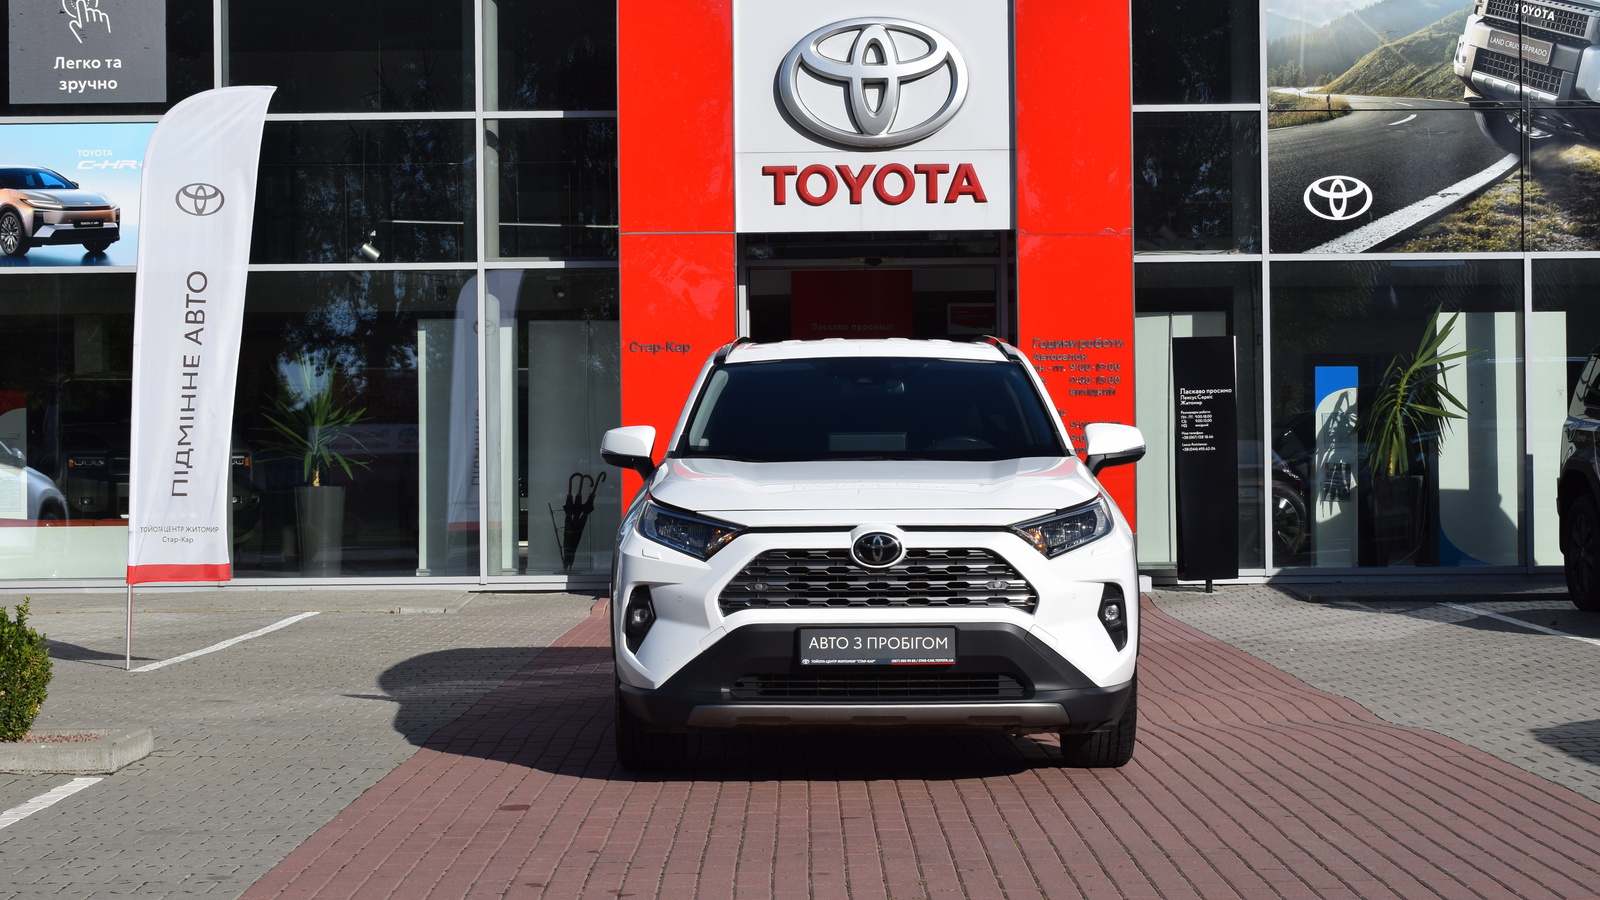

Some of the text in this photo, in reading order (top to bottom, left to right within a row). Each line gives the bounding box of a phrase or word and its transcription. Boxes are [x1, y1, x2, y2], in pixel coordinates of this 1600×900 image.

[1514, 3, 1555, 21] TOYOTA
[1490, 36, 1504, 46] LAND
[1528, 46, 1547, 56] PRADO
[53, 56, 122, 70] Легко та
[58, 79, 118, 93] зручно
[77, 149, 113, 157] TOYOTA
[762, 163, 988, 206] TOYOTA
[851, 323, 894, 332] просимо!
[629, 341, 691, 355] Стар-Кар
[1032, 337, 1124, 350] Години роботи
[1033, 352, 1087, 361] Автосалон
[171, 270, 208, 497] ПІДМІННЕ АВТО
[1069, 386, 1117, 397] вихідний
[163, 525, 184, 533] ЦЕНТР
[161, 535, 194, 544] Стар-Кар
[808, 636, 849, 650] АВТО
[867, 636, 948, 650] ПРОБІГОМ
